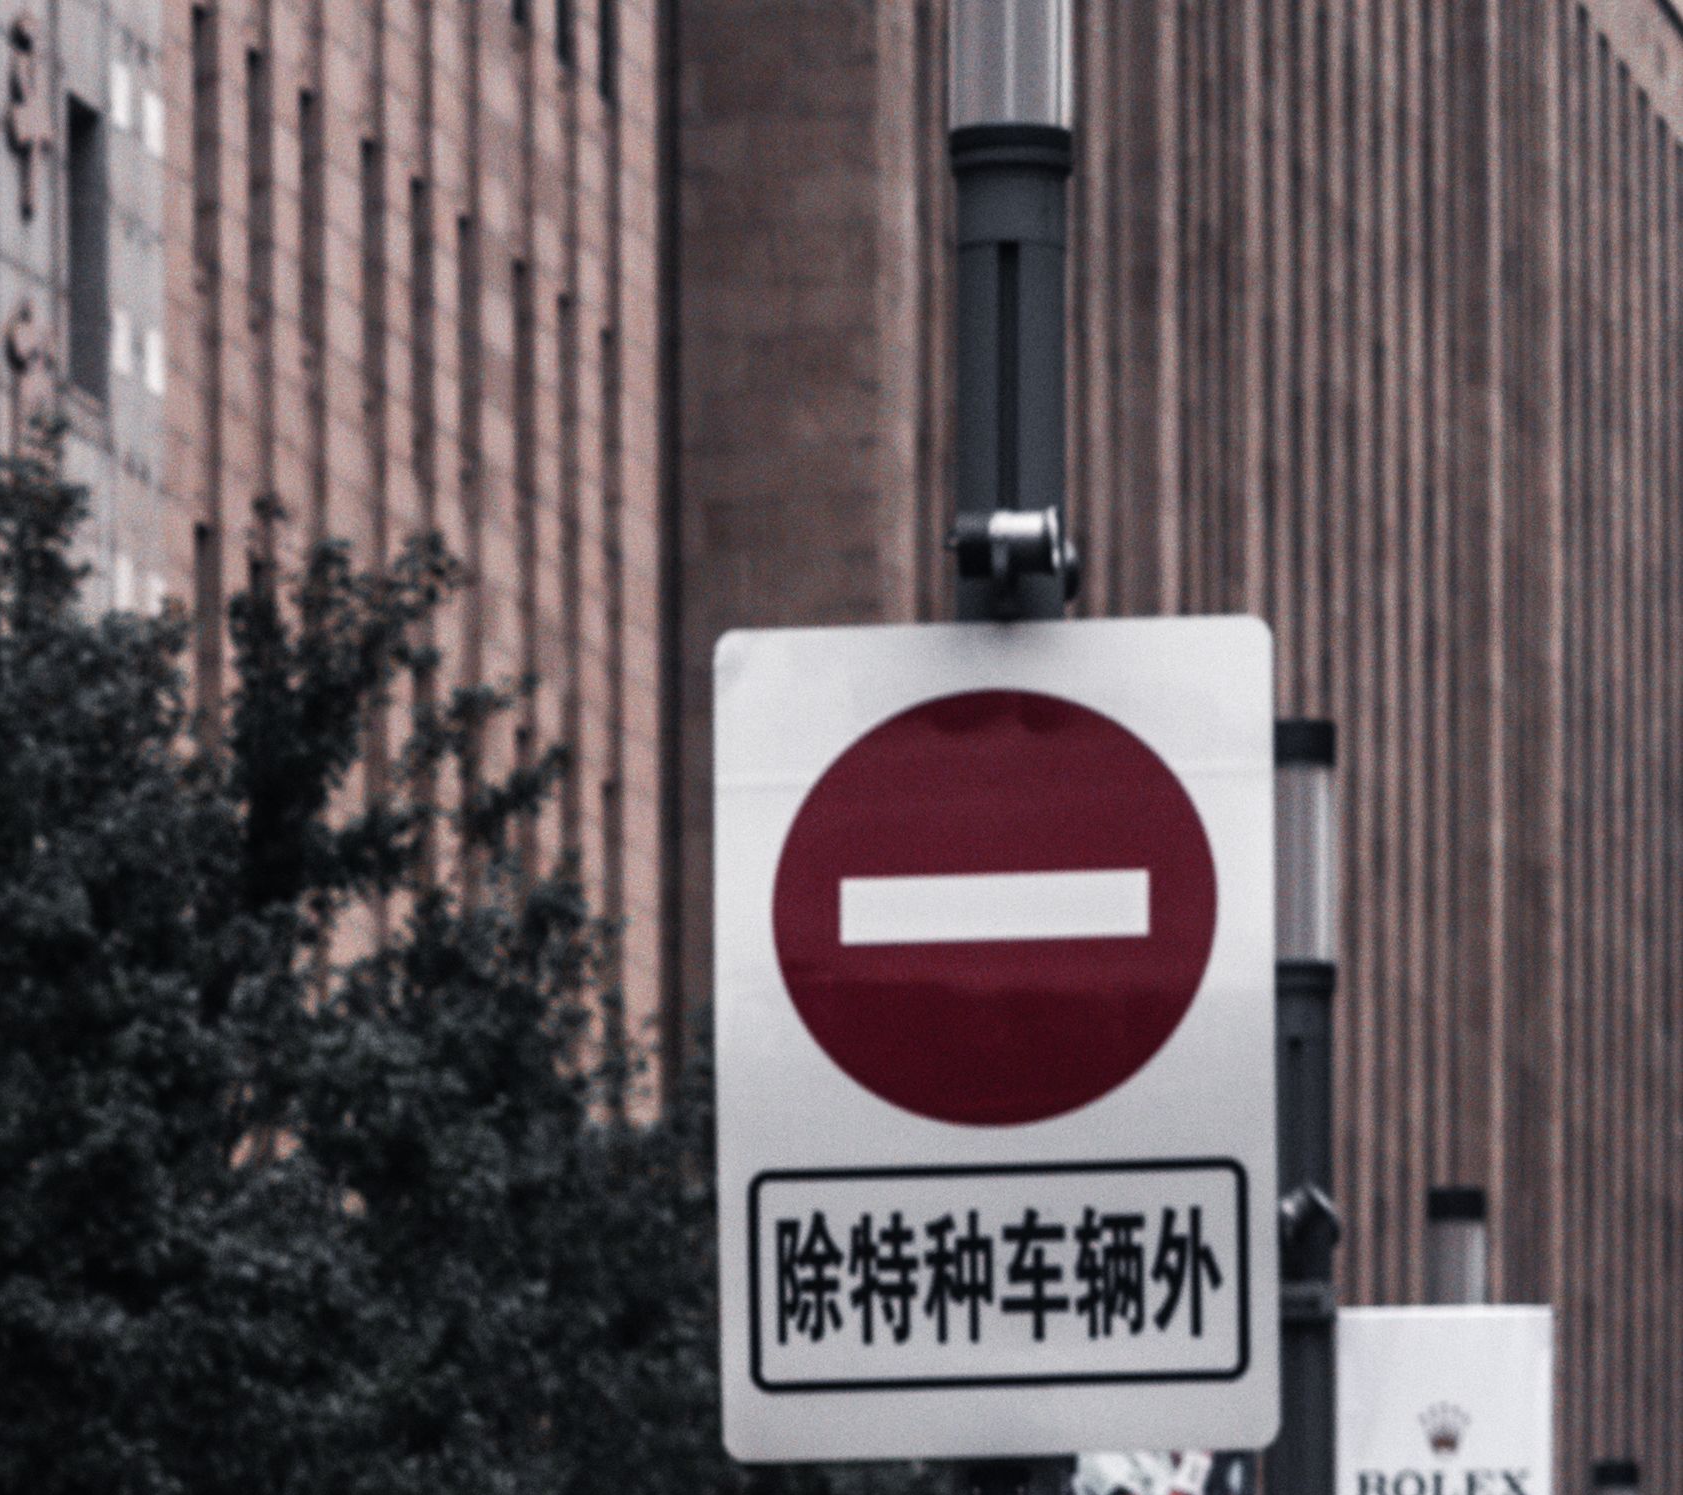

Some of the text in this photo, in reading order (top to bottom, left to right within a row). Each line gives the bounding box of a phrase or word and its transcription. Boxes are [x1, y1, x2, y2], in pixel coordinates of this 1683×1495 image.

[774, 1204, 1222, 1346] 除特种车辆外
